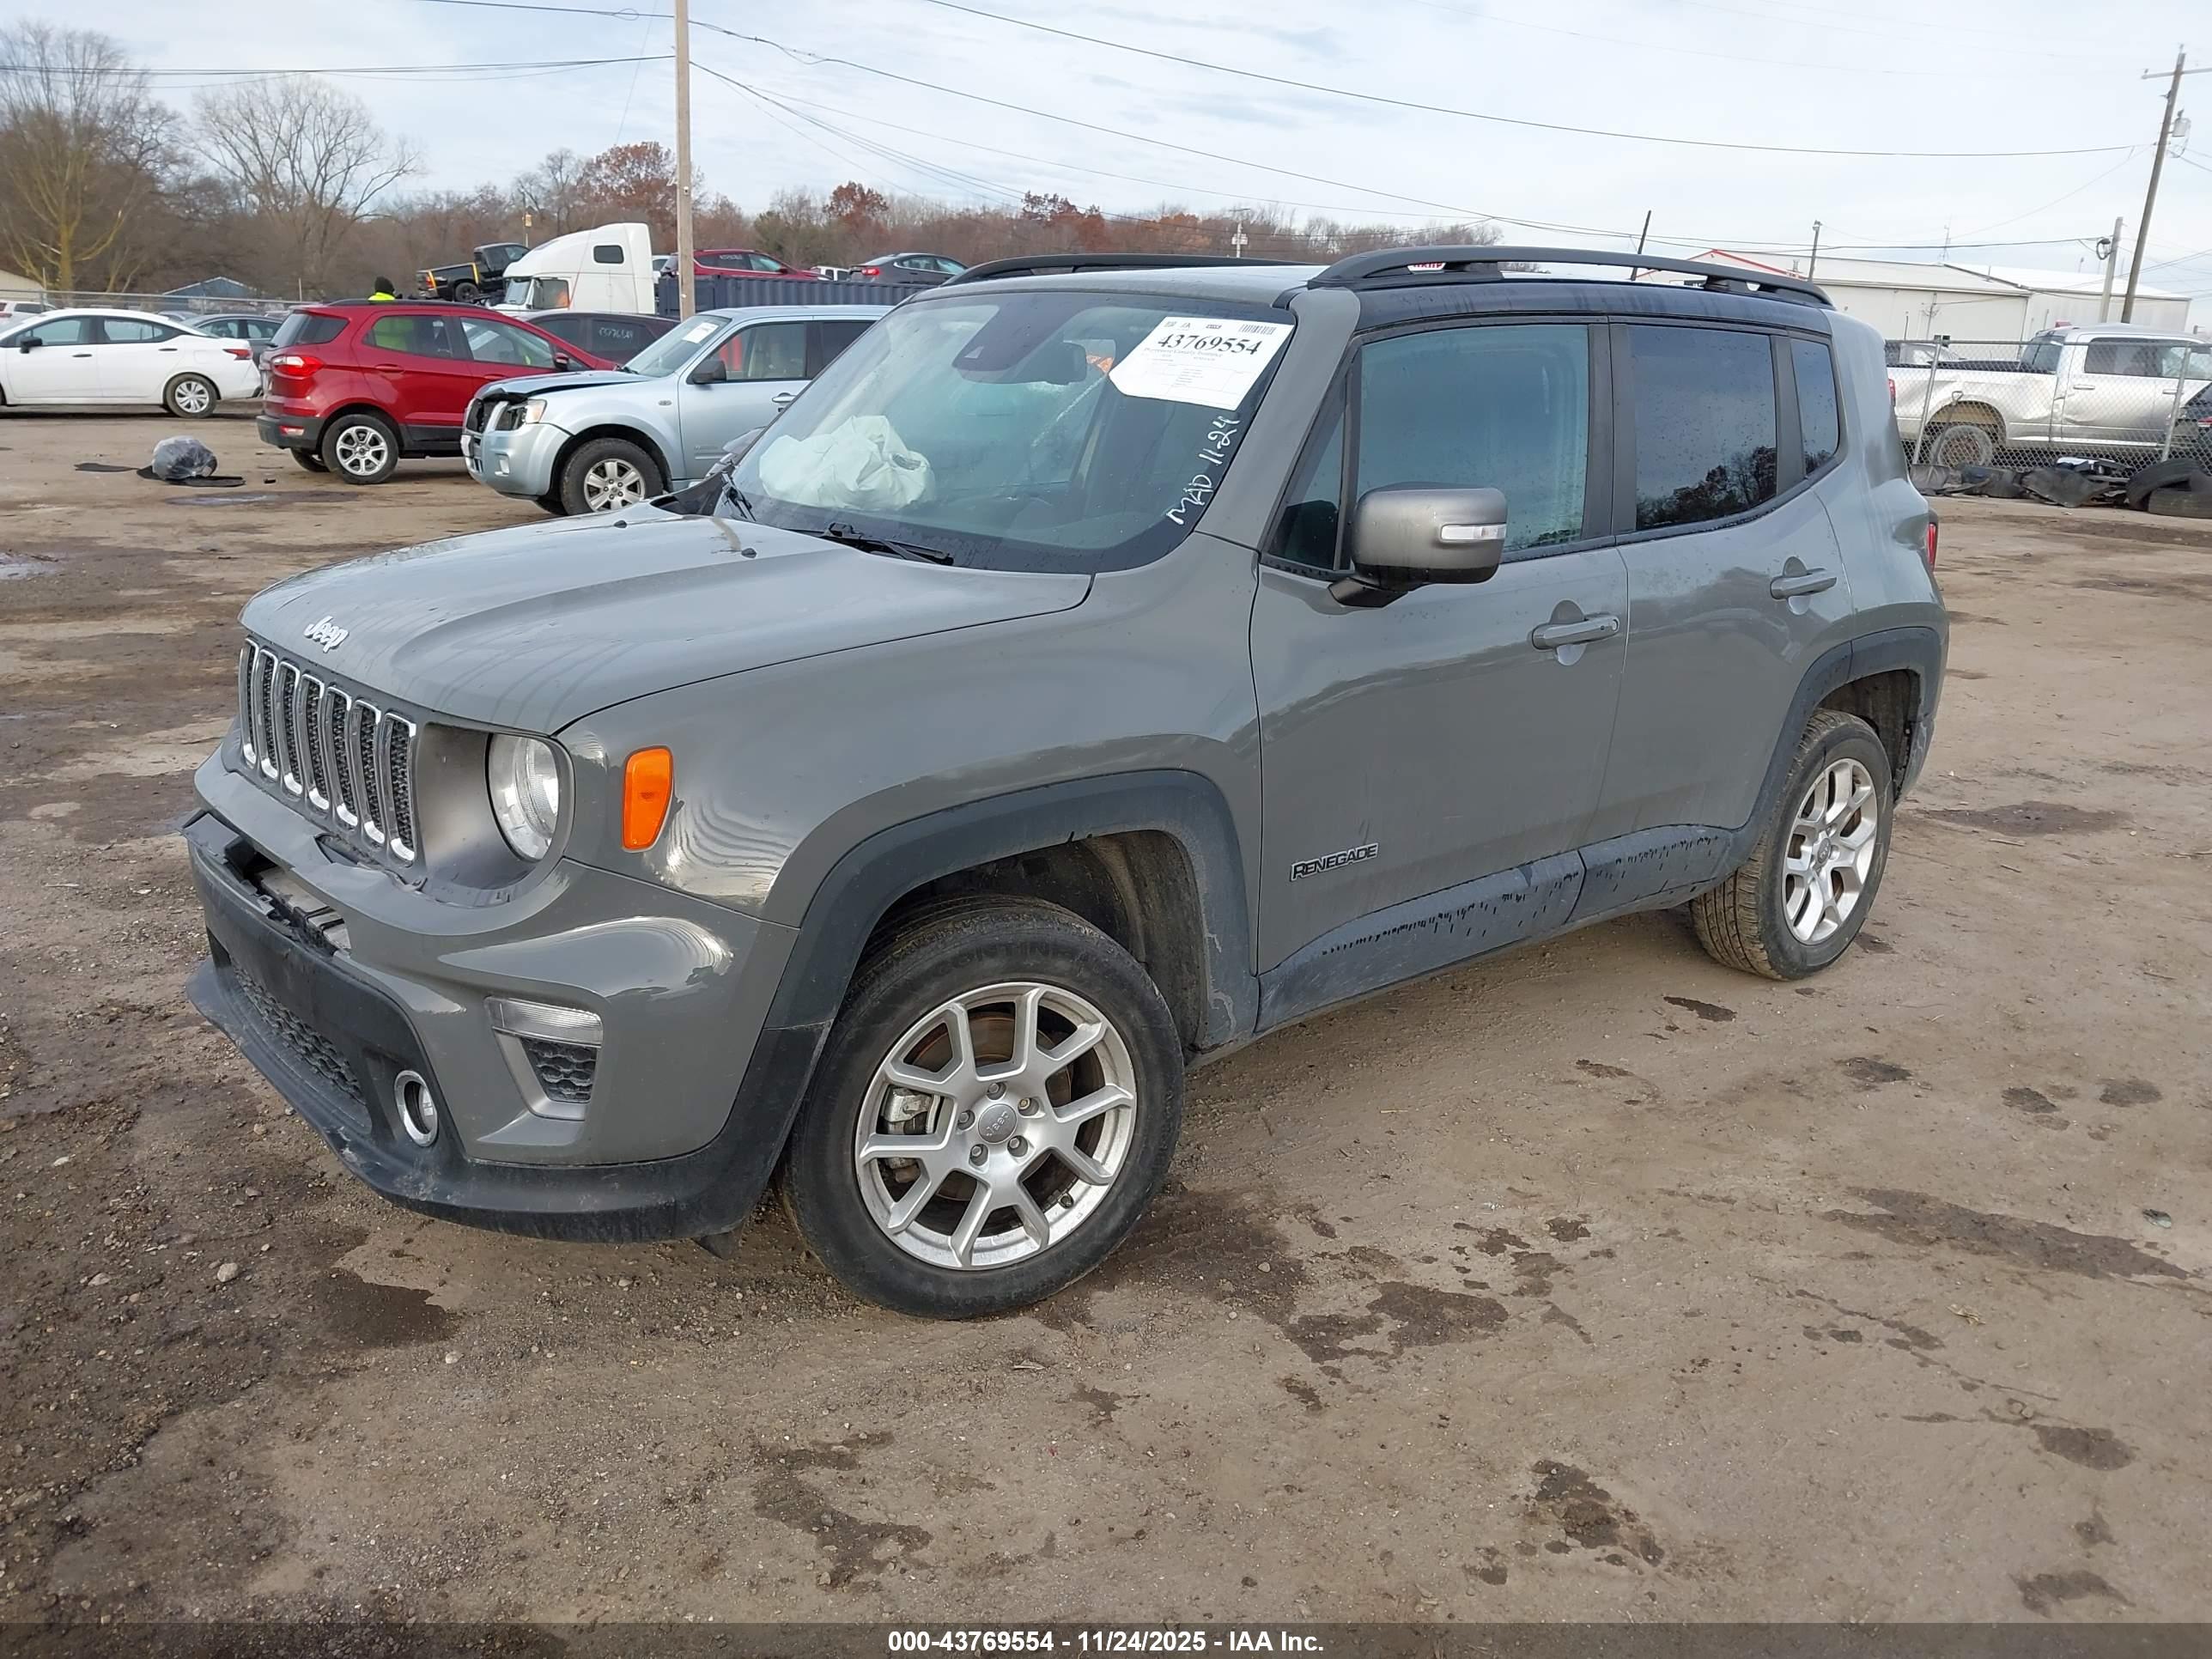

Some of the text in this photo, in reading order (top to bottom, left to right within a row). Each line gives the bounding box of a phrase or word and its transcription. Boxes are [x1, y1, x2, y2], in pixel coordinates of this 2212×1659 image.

[1158, 333, 1263, 356] 43769554
[1198, 416, 1241, 465] 11-24
[303, 615, 349, 653] Jeep
[1291, 842, 1378, 881] RENEGADE
